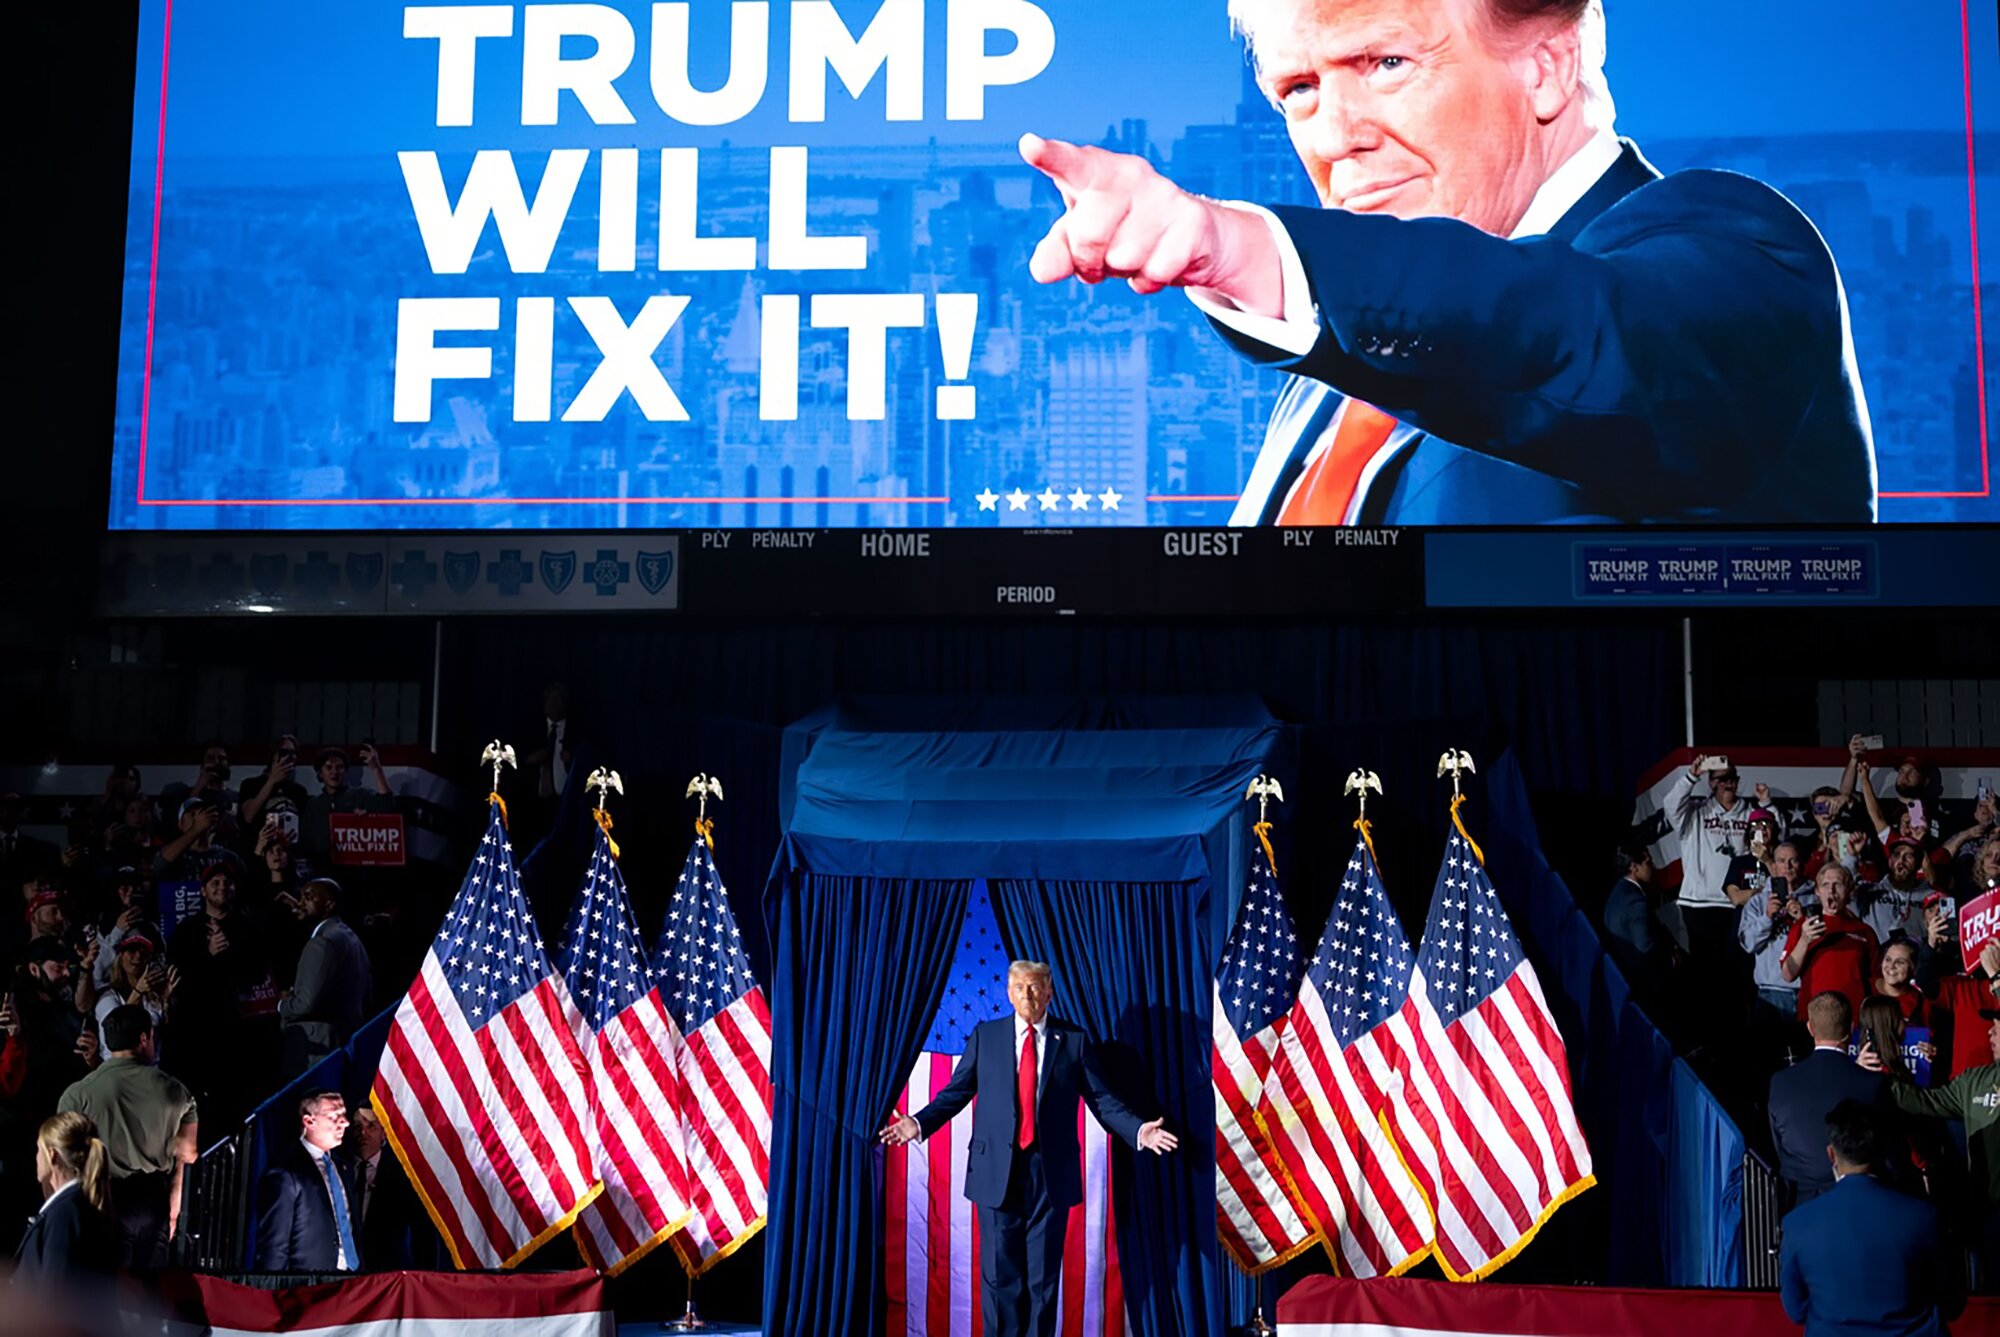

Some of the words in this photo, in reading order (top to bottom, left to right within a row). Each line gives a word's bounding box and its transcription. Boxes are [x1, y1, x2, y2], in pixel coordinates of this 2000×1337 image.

[403, 0, 1056, 126] TRUMP
[397, 146, 867, 274] WILL
[393, 296, 692, 422] FIX
[759, 293, 978, 421] IT!
[701, 532, 732, 548] PLY
[752, 532, 815, 548] PENALTY
[860, 533, 930, 557] HOME
[1163, 532, 1243, 556] GUEST
[1283, 530, 1314, 546] PLY
[1335, 530, 1400, 546] PENALTY
[1588, 560, 1649, 573] TRUMP
[1658, 560, 1719, 573] TRUMP
[1731, 559, 1792, 572] TRUMP
[1801, 559, 1862, 572] TRUMP
[1589, 573, 1617, 582] WILL
[1618, 573, 1636, 582] FIX
[1637, 573, 1649, 582] IT
[1659, 572, 1687, 581] WILL
[1687, 572, 1706, 581] FIX
[1707, 572, 1718, 581] IT
[1732, 572, 1760, 581] WILL
[1761, 572, 1779, 581] FIX
[1781, 572, 1792, 581] IT
[1802, 572, 1830, 581] WILL
[1831, 572, 1849, 581] FIX
[1851, 572, 1862, 581] IT
[997, 586, 1056, 603] PERIOD
[334, 827, 399, 843] TRUMP
[336, 842, 365, 852] WILL
[367, 842, 386, 852] FIX
[388, 842, 399, 852] IT
[174, 885, 187, 911] BIG,
[1963, 904, 2000, 939] TRU
[1964, 928, 1989, 951] WILL
